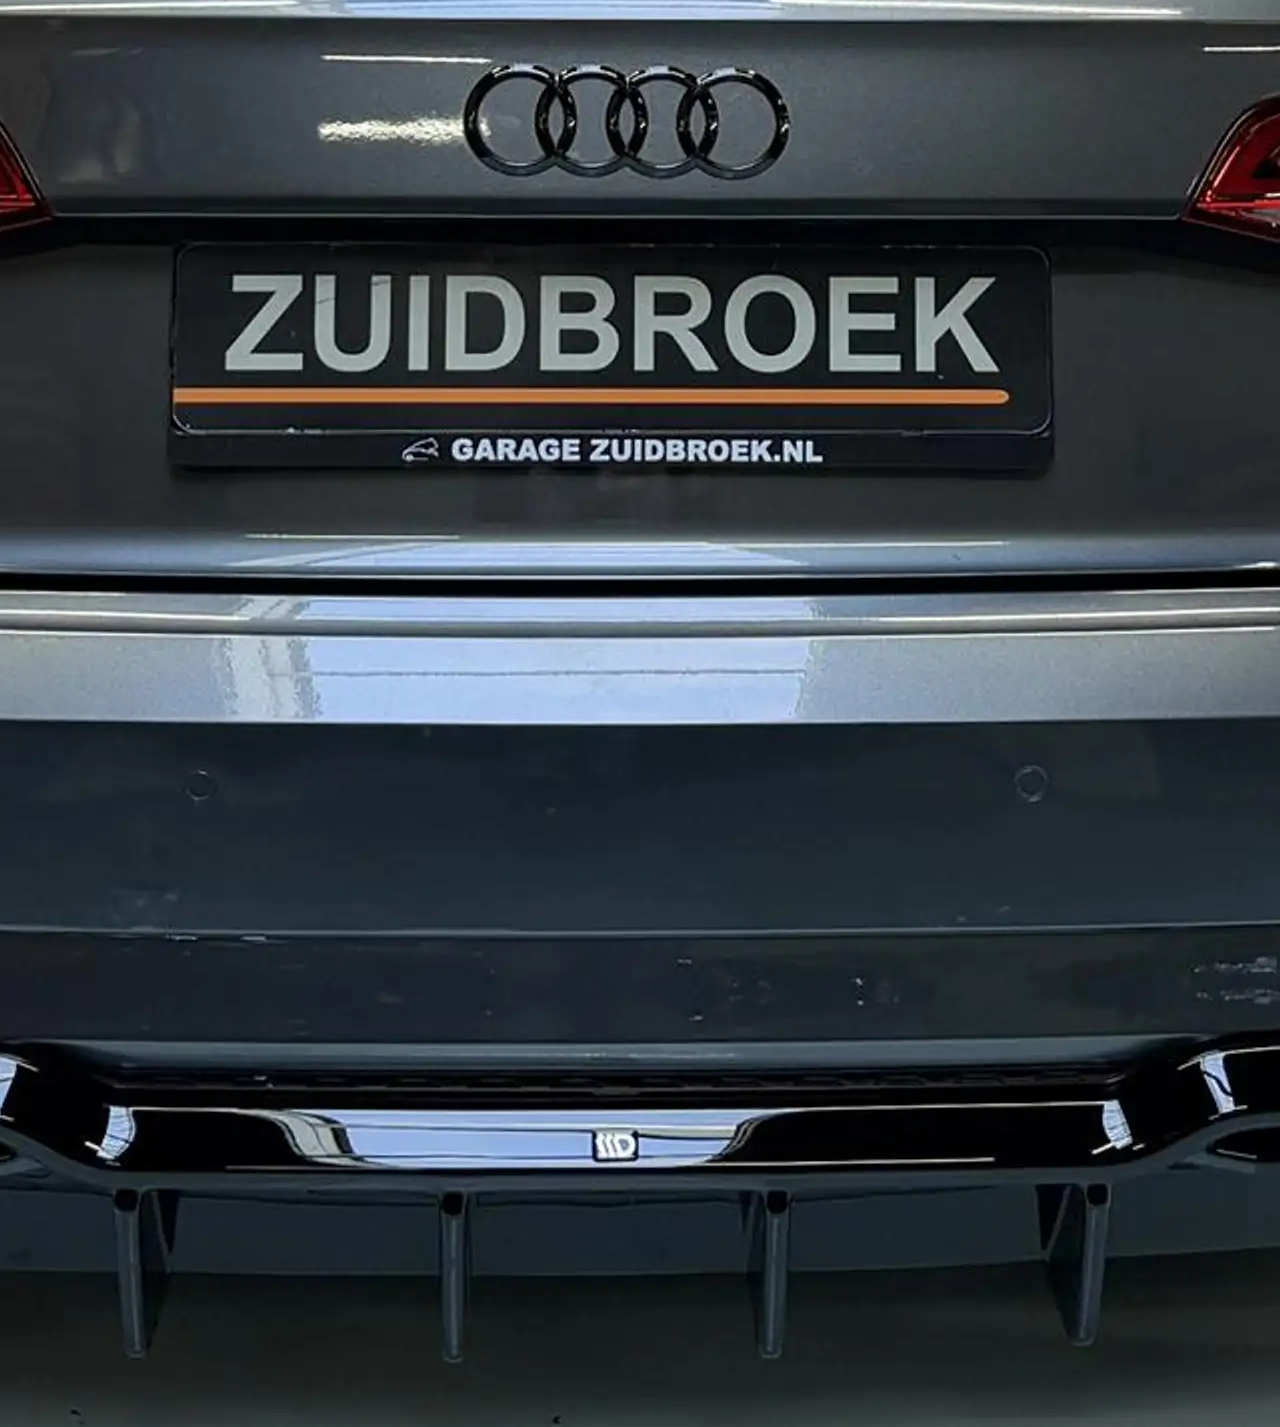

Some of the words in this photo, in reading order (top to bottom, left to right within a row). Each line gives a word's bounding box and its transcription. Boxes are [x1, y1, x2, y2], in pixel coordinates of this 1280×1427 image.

[224, 274, 1001, 374] ZUIDBROEK
[451, 437, 581, 462] GARAGE
[589, 438, 823, 463] ZUIDBROEK.NL
